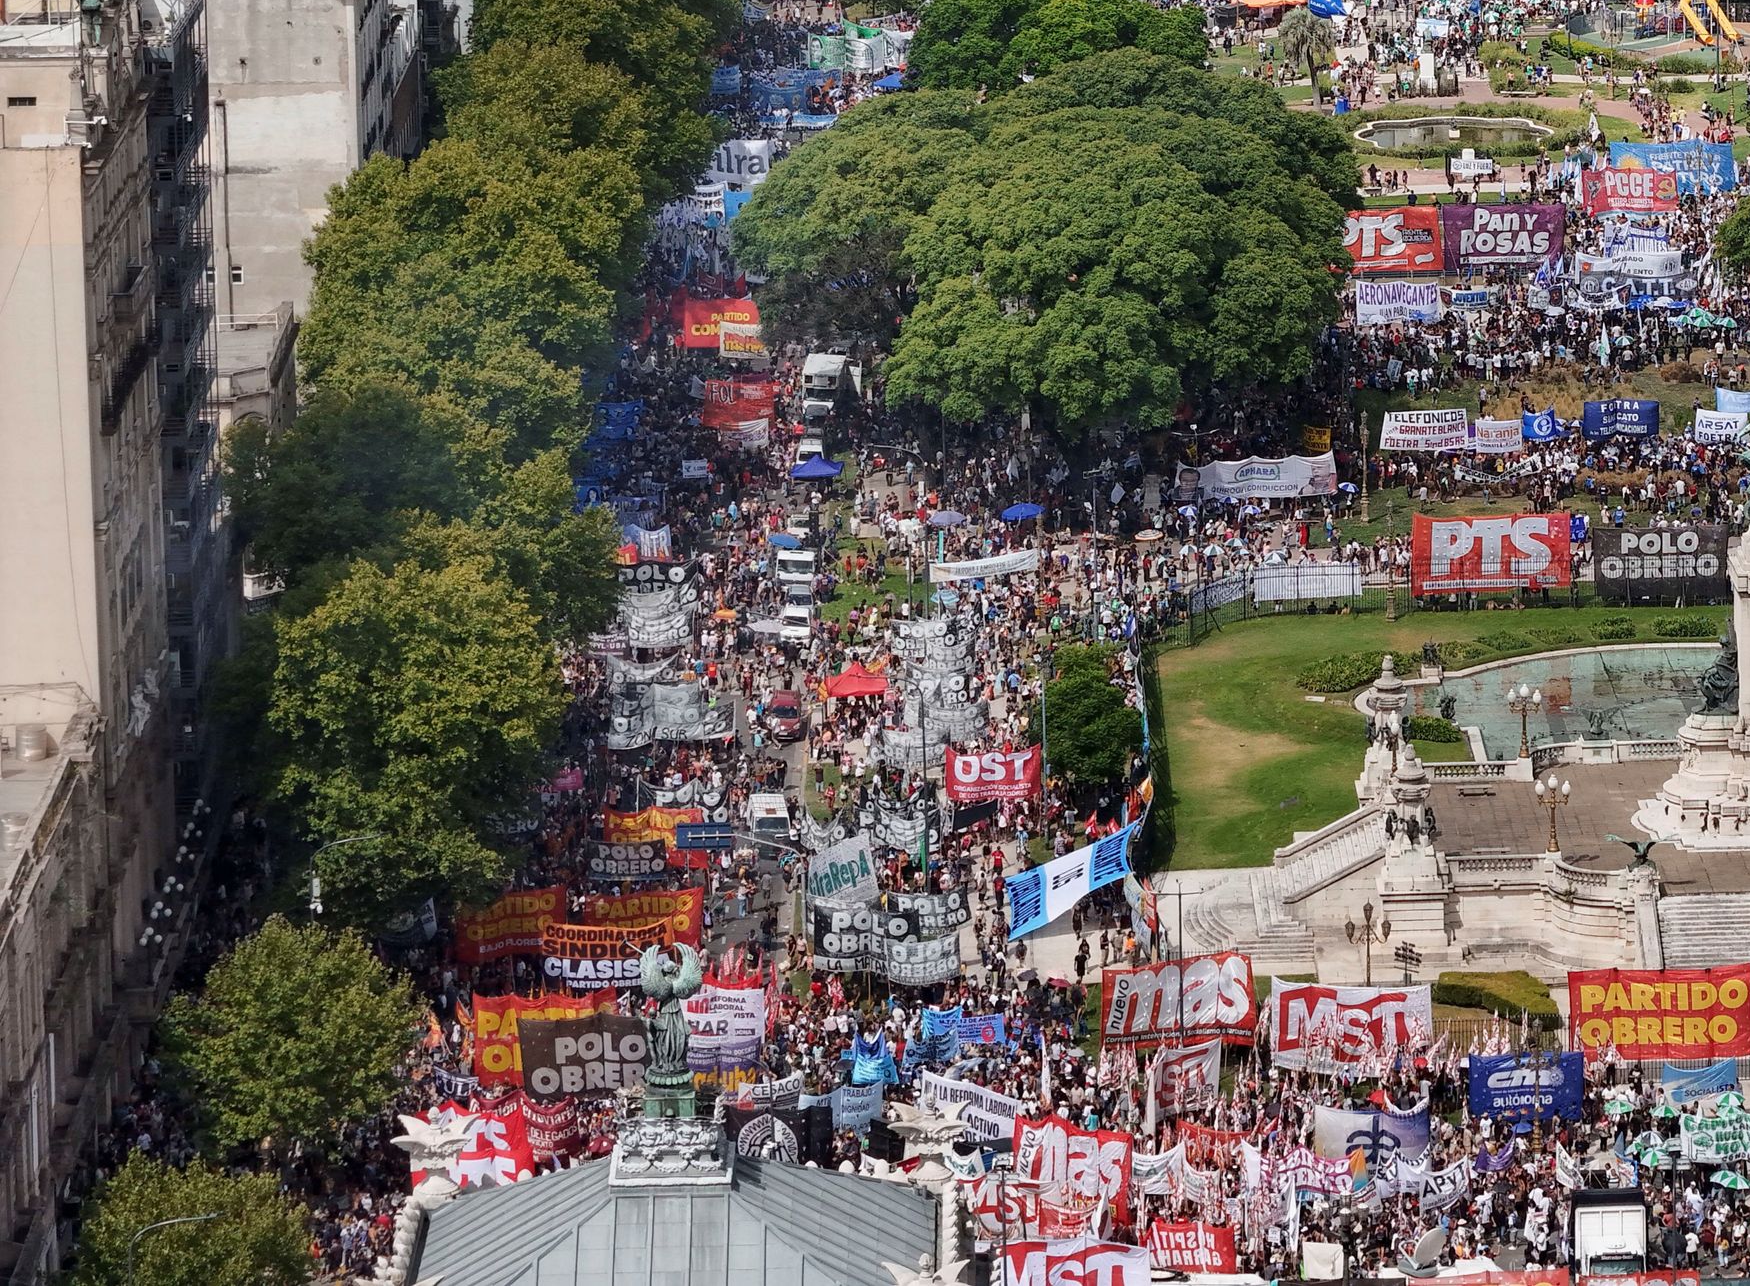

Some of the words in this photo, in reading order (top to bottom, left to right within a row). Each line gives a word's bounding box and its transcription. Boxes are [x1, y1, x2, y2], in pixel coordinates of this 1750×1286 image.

[1604, 170, 1654, 197] PCCE
[1358, 282, 1439, 307] AERONAVEGANTES
[711, 312, 751, 322] PARTIDO
[1399, 423, 1437, 435] GRANATE
[1437, 421, 1466, 434] BLANCA
[1476, 426, 1520, 440] Naranja
[1697, 419, 1739, 431] ARSAT
[1384, 437, 1419, 448] FOETRA
[1698, 431, 1739, 443] FOETRA
[1430, 517, 1553, 576] PTS
[1620, 532, 1700, 555] POLO
[1600, 553, 1720, 580] OBRERO
[661, 727, 688, 741] SUR
[954, 750, 1034, 783] OST
[980, 790, 1029, 798] TRABAJADORES
[998, 783, 1032, 791] SOCIALISTA
[598, 844, 654, 861] POLO
[590, 857, 665, 875] OBRERO
[594, 894, 694, 919] PARTIDO
[897, 892, 961, 914] POLO
[545, 922, 667, 942] COORDINADORA
[831, 912, 909, 936] POLO
[479, 942, 505, 955] BAJO
[505, 937, 543, 947] FLORES
[827, 955, 844, 971] LA
[566, 978, 610, 989] PARTIDO
[1110, 978, 1129, 1031] nuevo
[1579, 978, 1749, 1013] PARTIDO
[709, 1003, 745, 1011] LABORAL
[1280, 986, 1411, 1061] MST
[1580, 1014, 1738, 1048] OBRERO
[1106, 1033, 1140, 1044] Corriente
[1187, 1027, 1221, 1036] Socialismo
[555, 1031, 648, 1065] POLO
[751, 1077, 800, 1097] CESACO
[939, 1087, 949, 1101] LA
[949, 1087, 984, 1111] REFORMA
[967, 1113, 1000, 1138] ACTIVO
[1714, 1131, 1744, 1142] HUGO
[1005, 1241, 1128, 1286] MST
